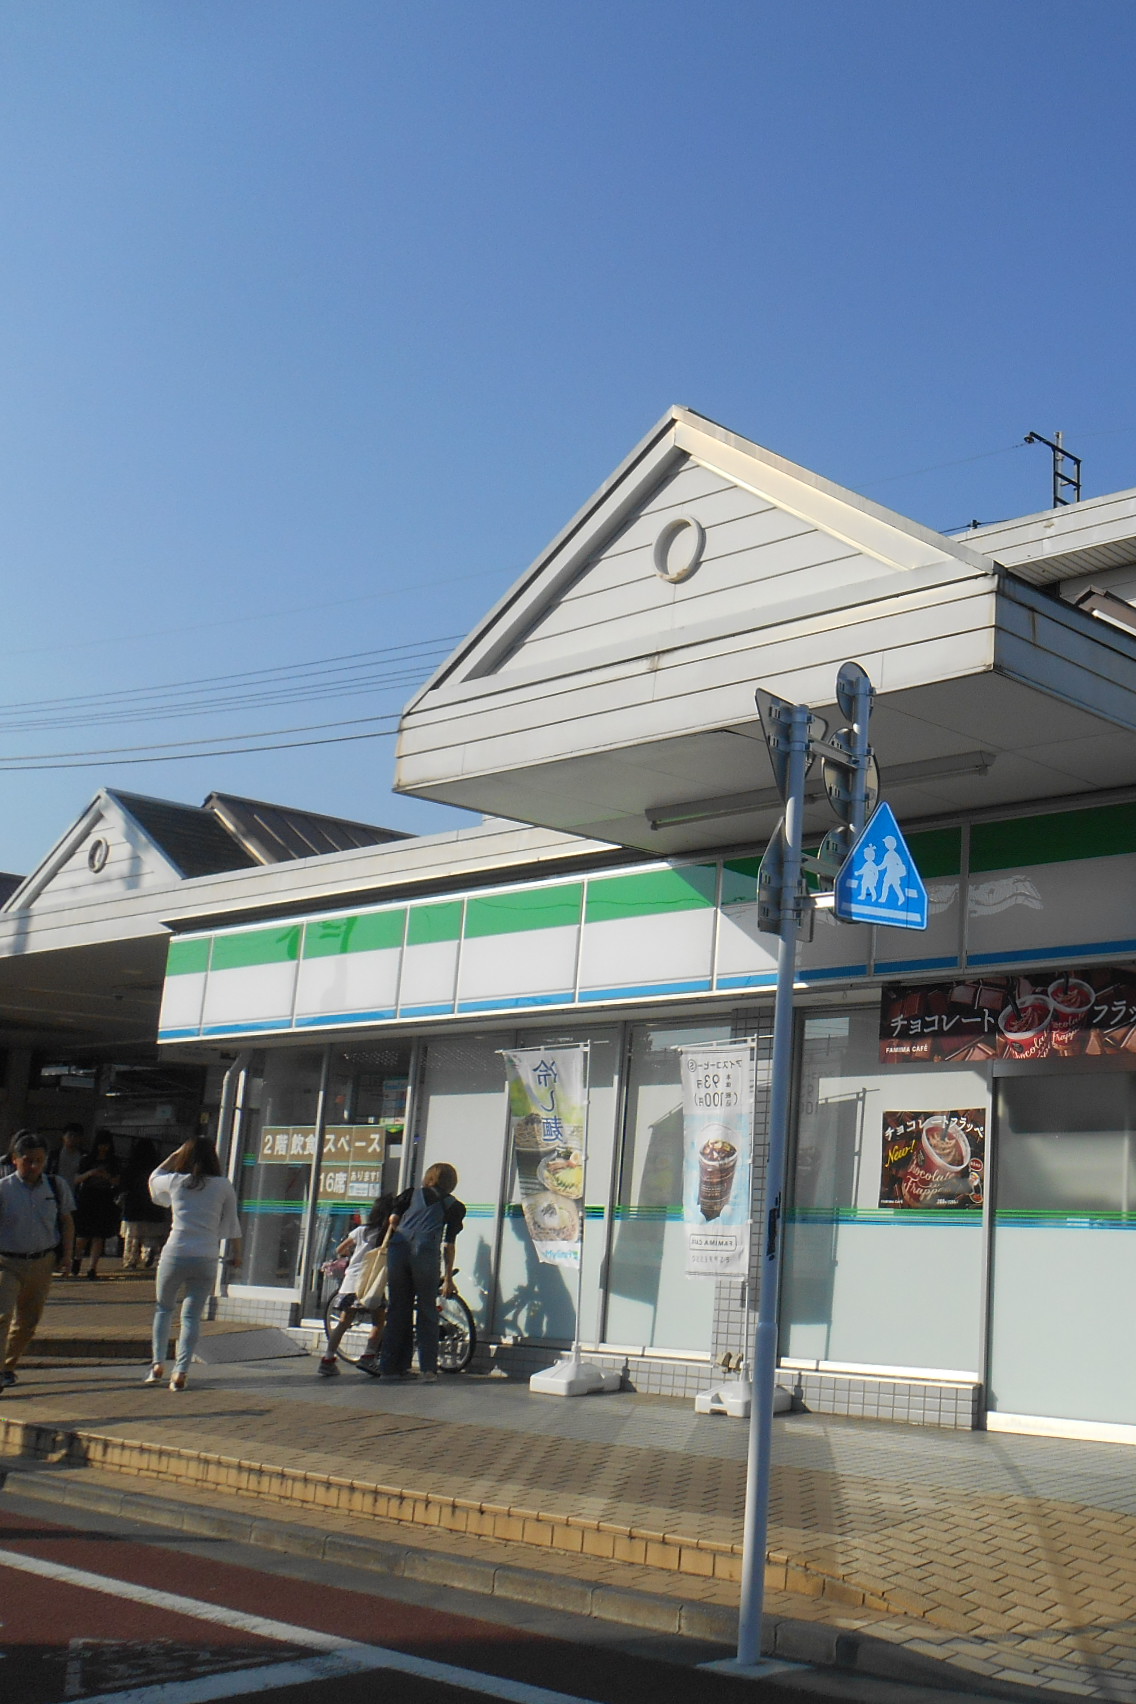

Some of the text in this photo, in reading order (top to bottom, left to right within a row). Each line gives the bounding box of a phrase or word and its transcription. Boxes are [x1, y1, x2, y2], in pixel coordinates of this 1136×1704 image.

[890, 1009, 995, 1038] チョコレート
[884, 1115, 984, 1141] チョコレートフラッペ
[884, 1140, 916, 1168] New!
[320, 1172, 347, 1194] 16席
